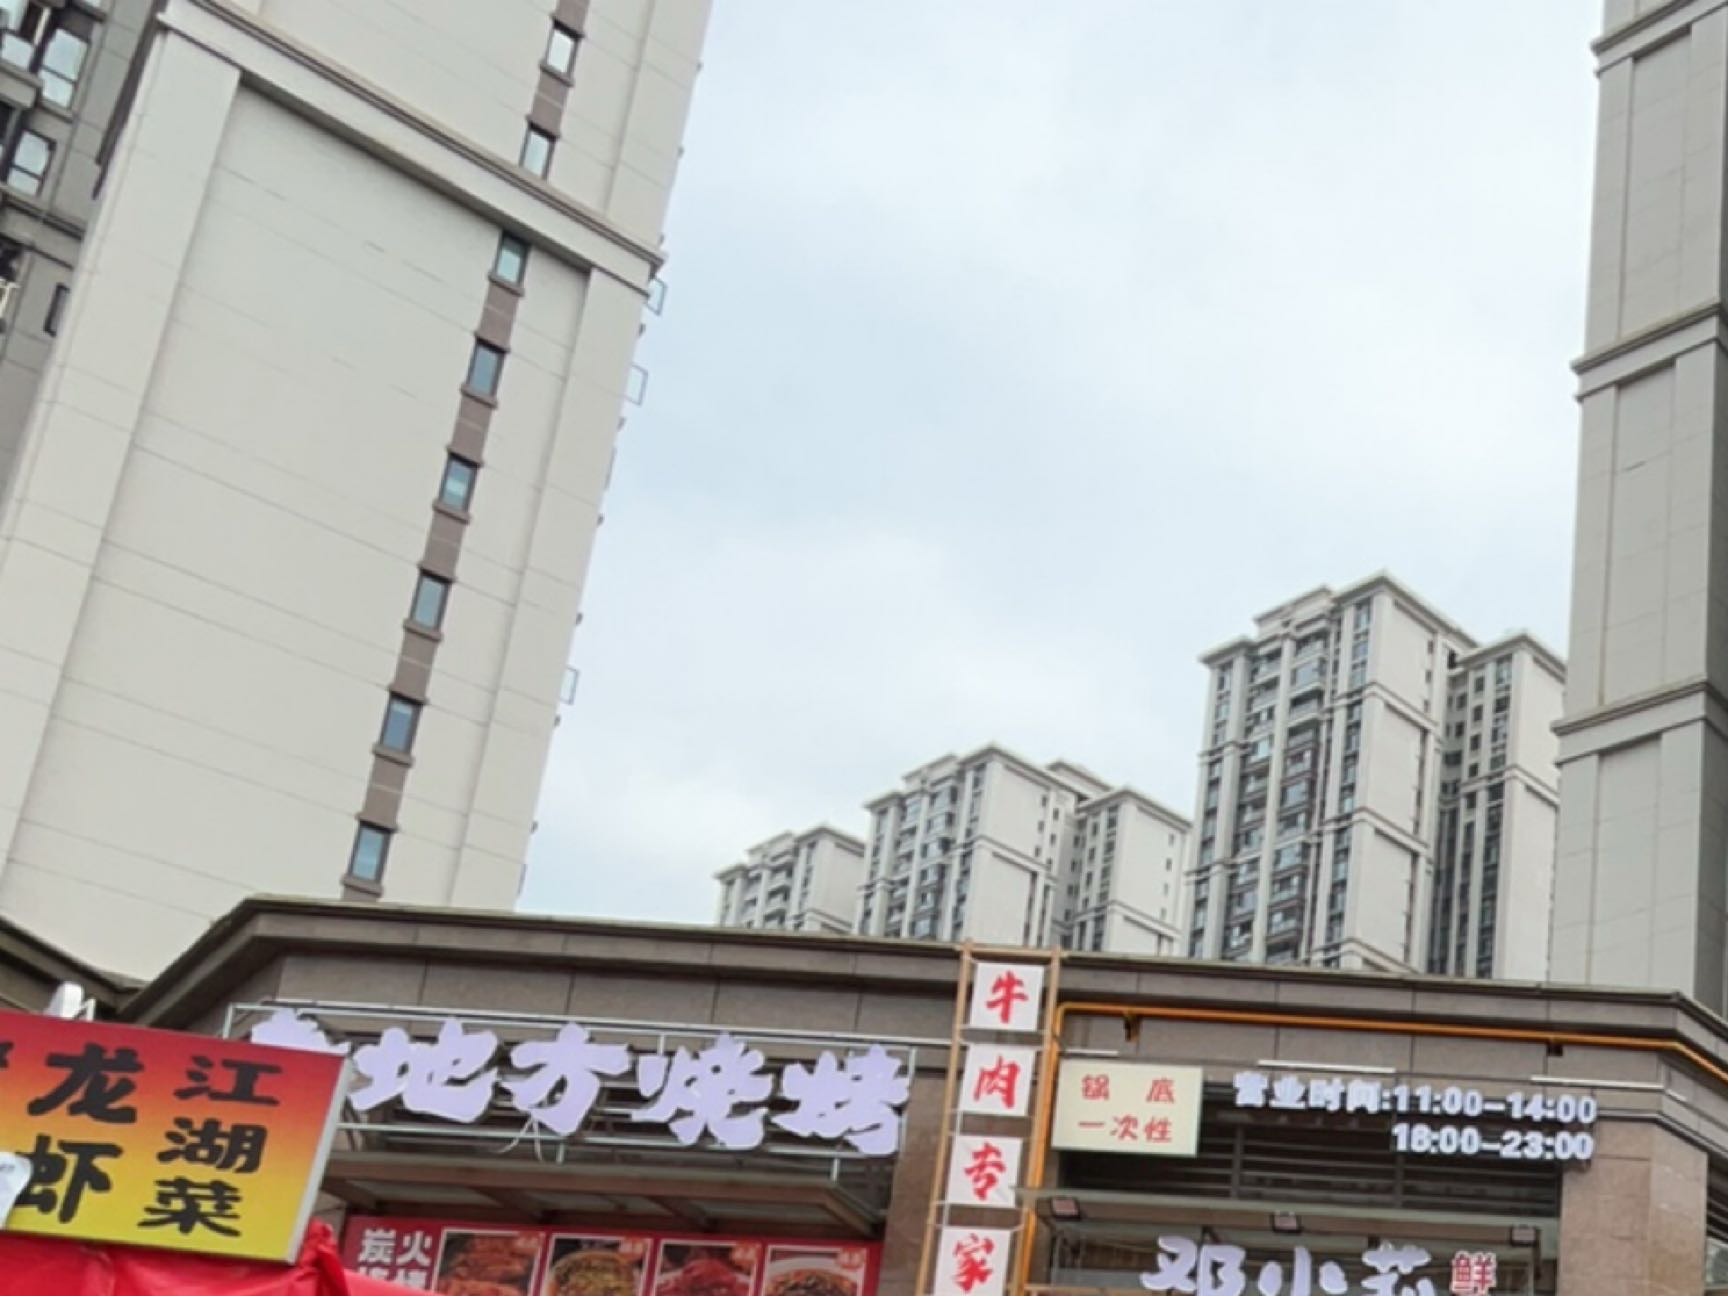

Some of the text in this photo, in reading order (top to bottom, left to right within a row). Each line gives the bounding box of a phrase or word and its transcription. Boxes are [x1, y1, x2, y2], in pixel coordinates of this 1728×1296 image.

[136, 1054, 283, 1238] 江湖菜
[952, 969, 1029, 1295] 牛肉专家
[1078, 1114, 1173, 1143] 一次性
[359, 1228, 434, 1267] 炭火
